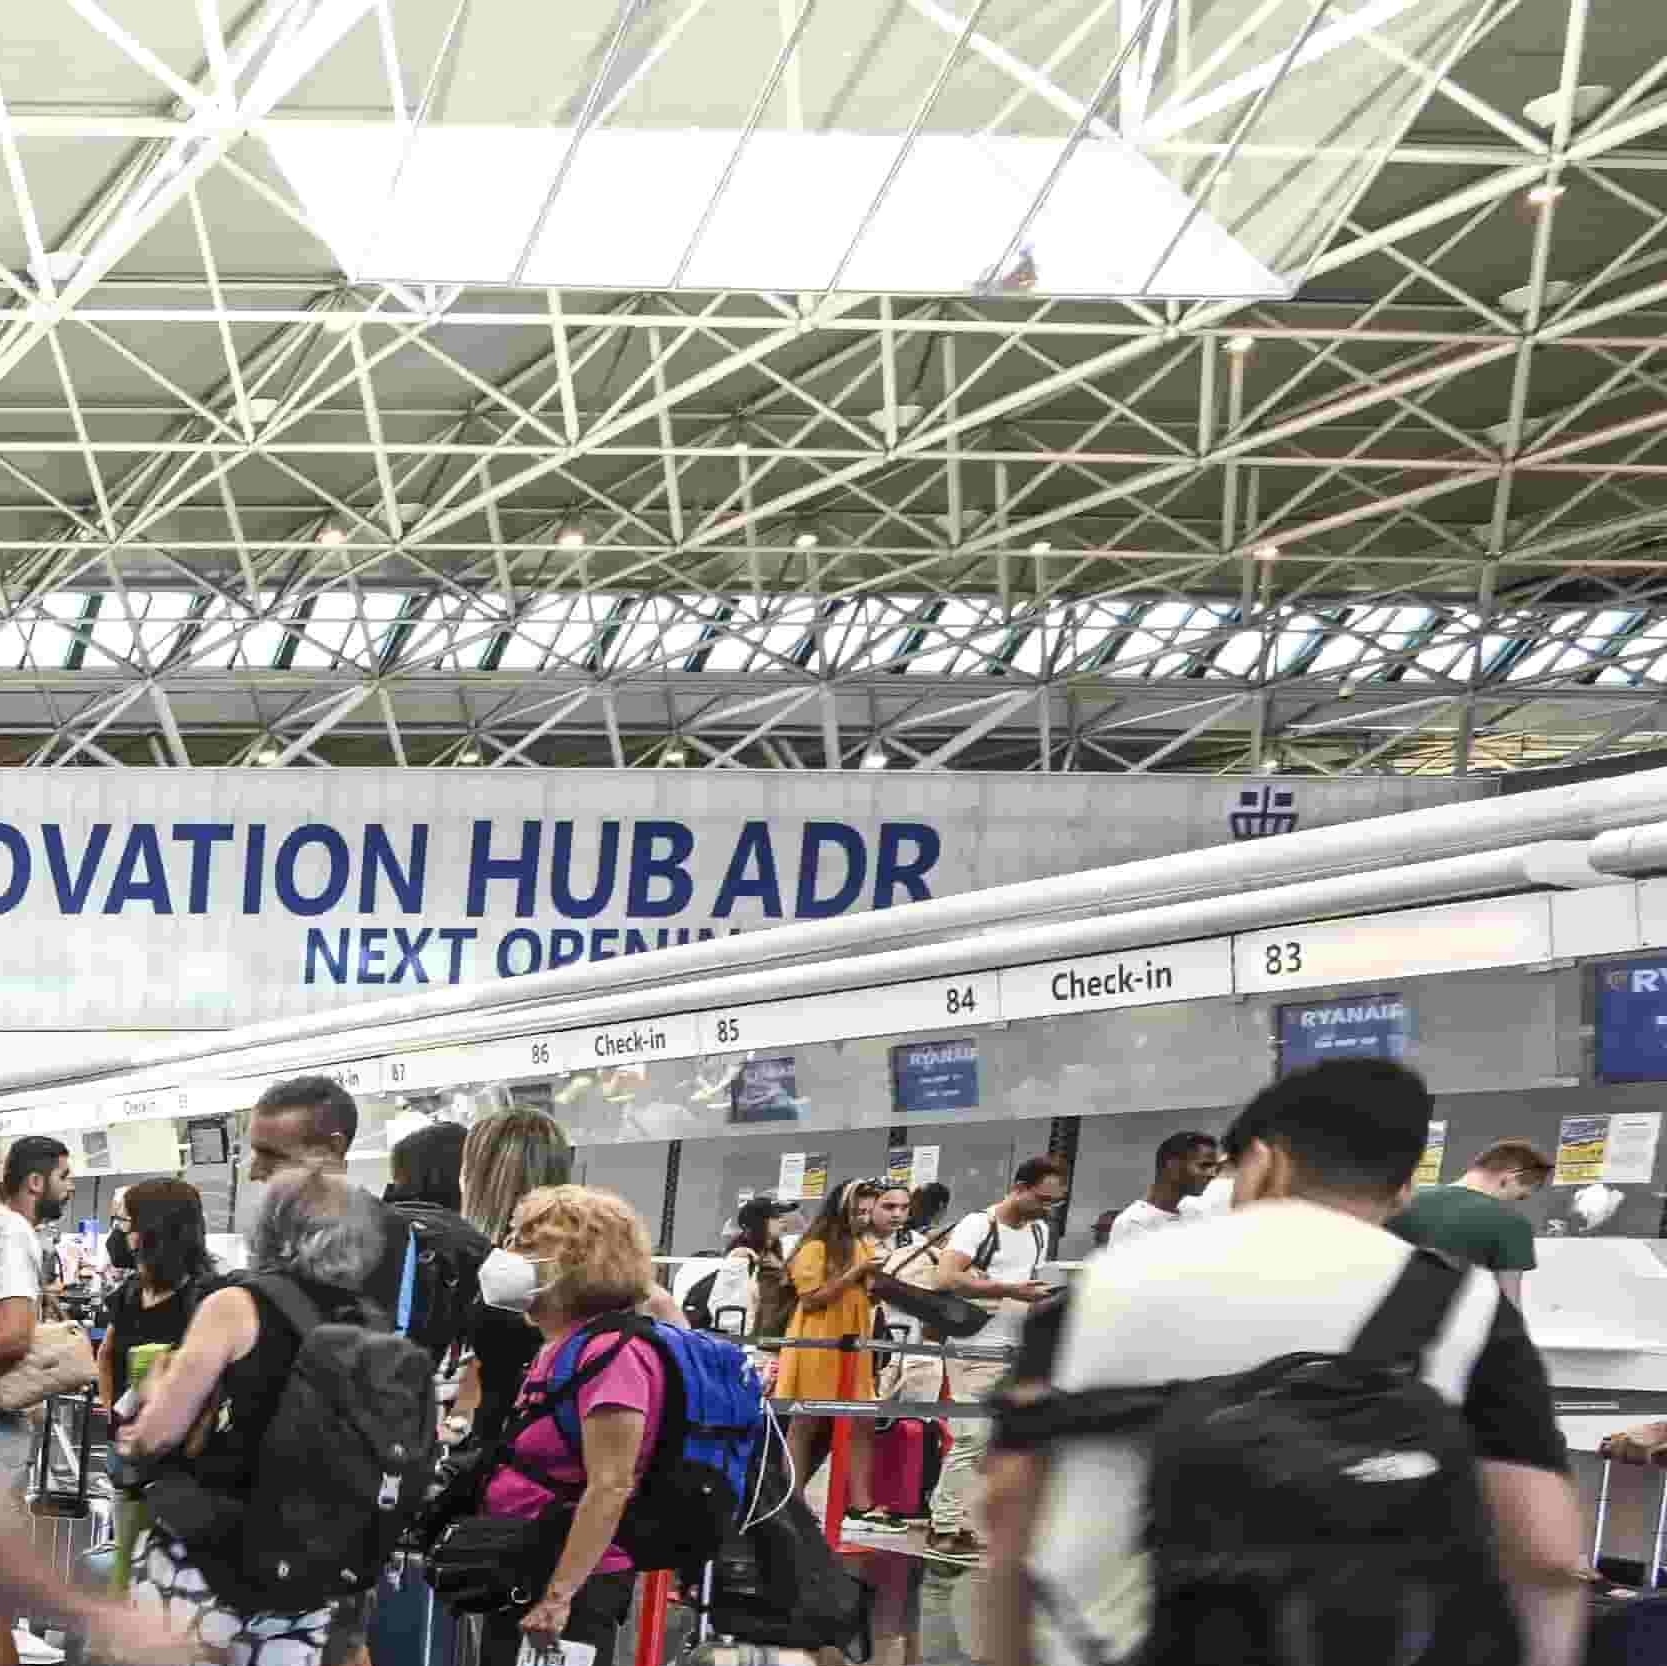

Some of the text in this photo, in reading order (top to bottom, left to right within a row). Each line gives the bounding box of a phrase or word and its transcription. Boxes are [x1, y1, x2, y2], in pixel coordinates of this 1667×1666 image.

[465, 819, 695, 919] HUB
[710, 821, 942, 919] ADR
[304, 928, 477, 984] NEXT
[1265, 943, 1302, 976] 83
[945, 963, 1172, 1014] 84 Check-in
[531, 1018, 740, 1064] 86 Check-in 85
